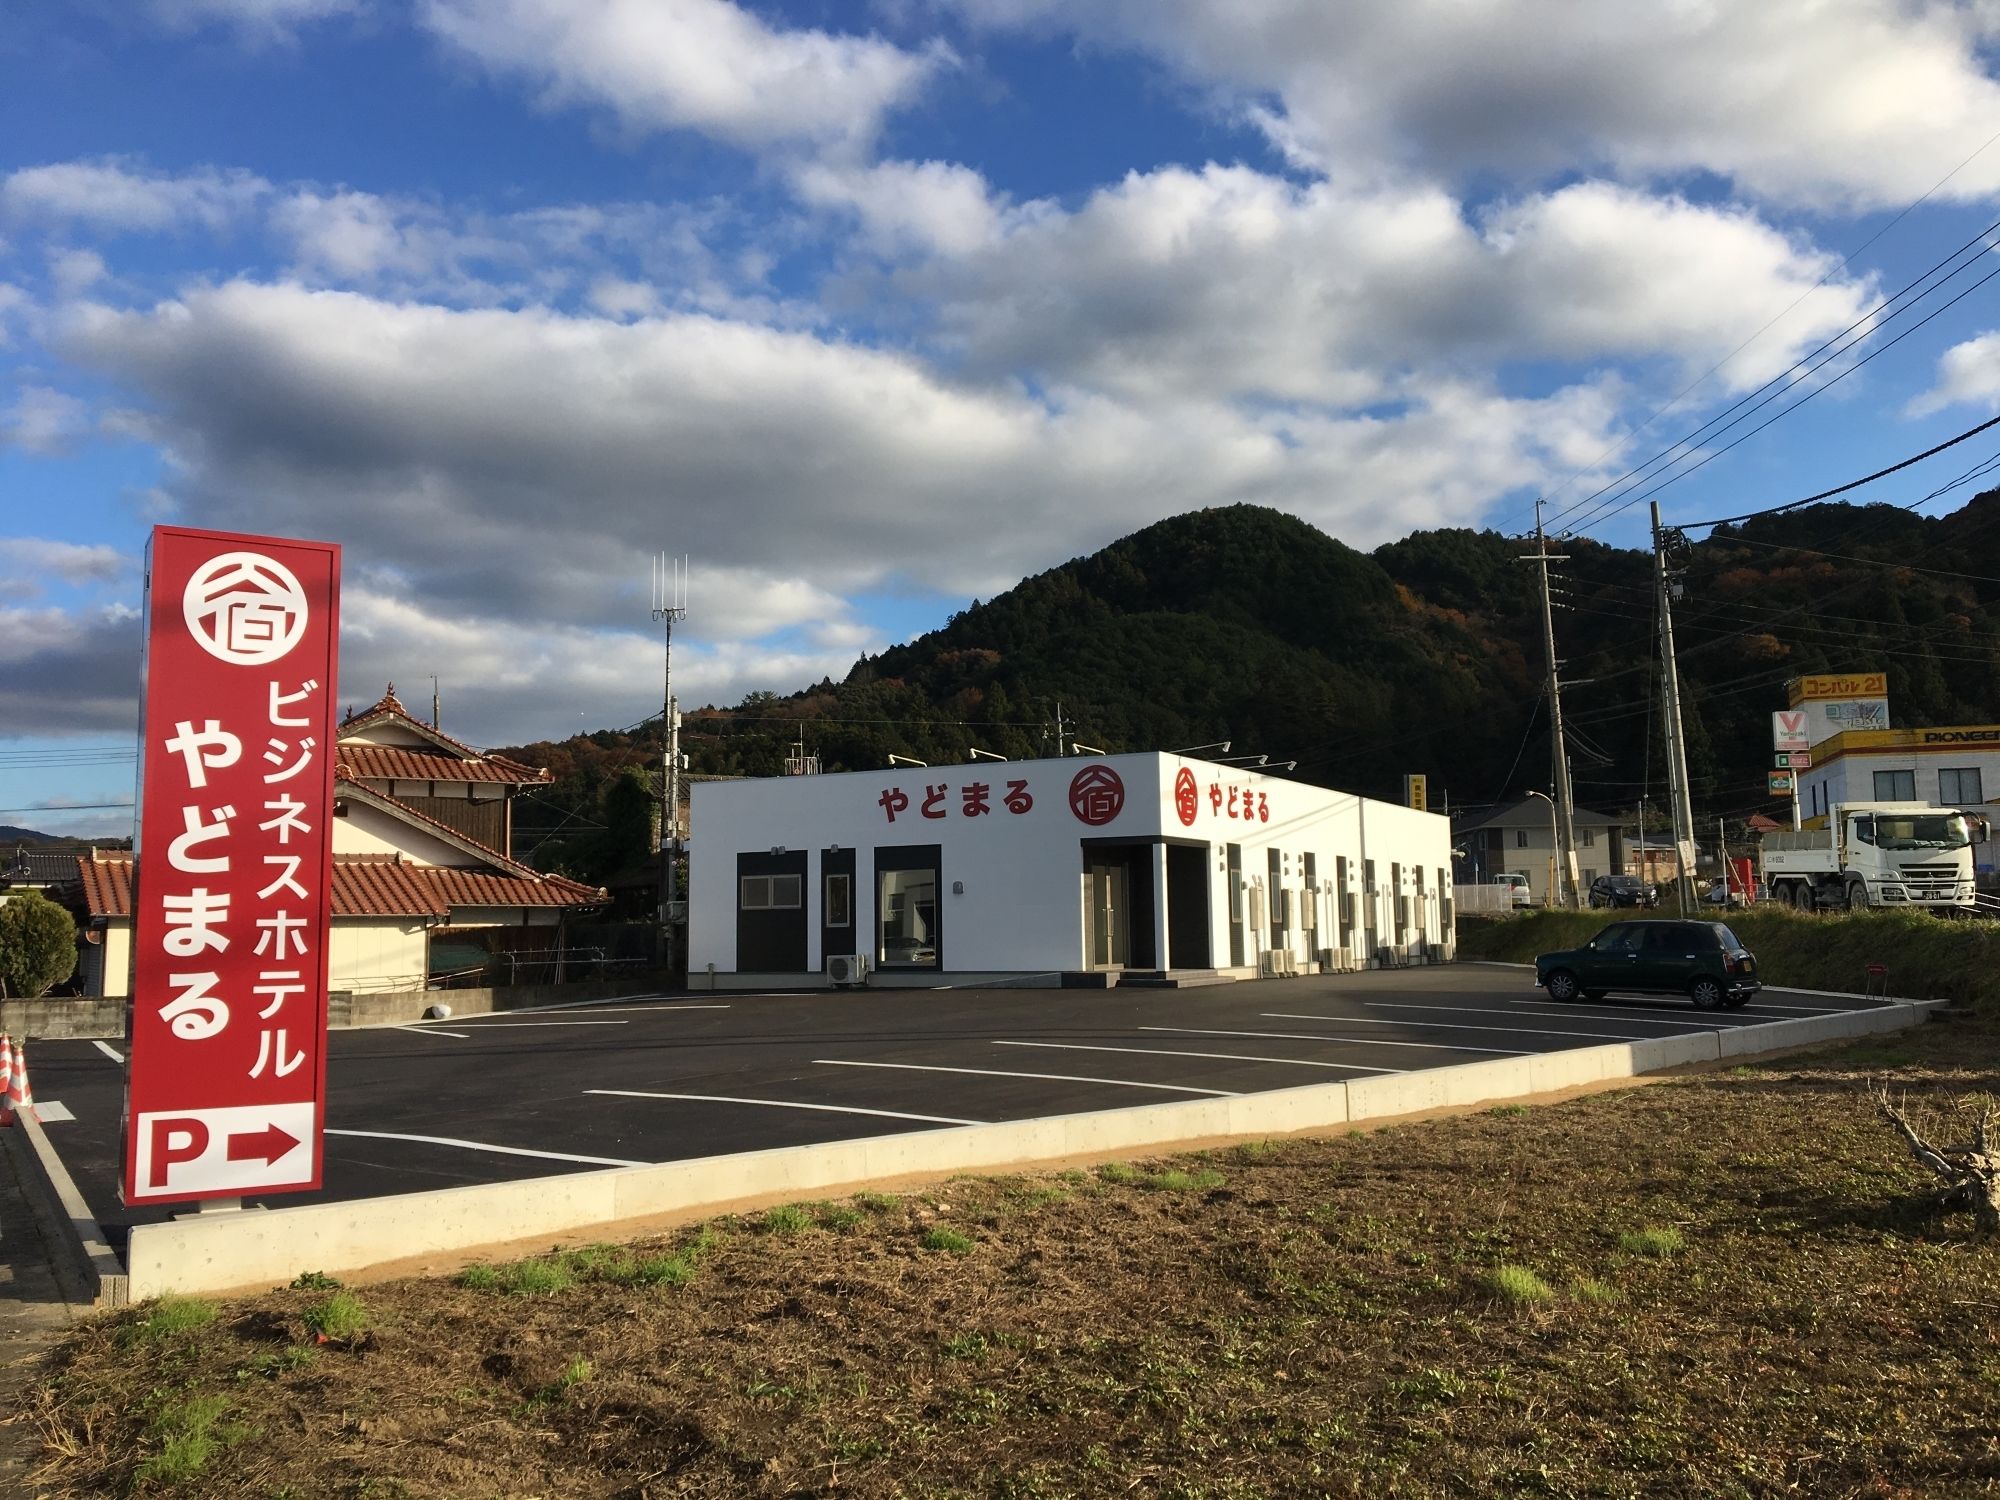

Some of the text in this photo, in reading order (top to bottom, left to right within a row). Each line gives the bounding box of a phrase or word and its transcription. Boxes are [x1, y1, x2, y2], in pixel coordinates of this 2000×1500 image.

[1807, 678, 1860, 695] コンパル
[1864, 675, 1884, 692] 21
[878, 779, 1034, 824] やどまる
[1208, 782, 1270, 824] やどまる
[157, 718, 245, 1041] やどまる
[247, 678, 321, 1080] ビジネスホテル
[150, 1118, 209, 1187] P
